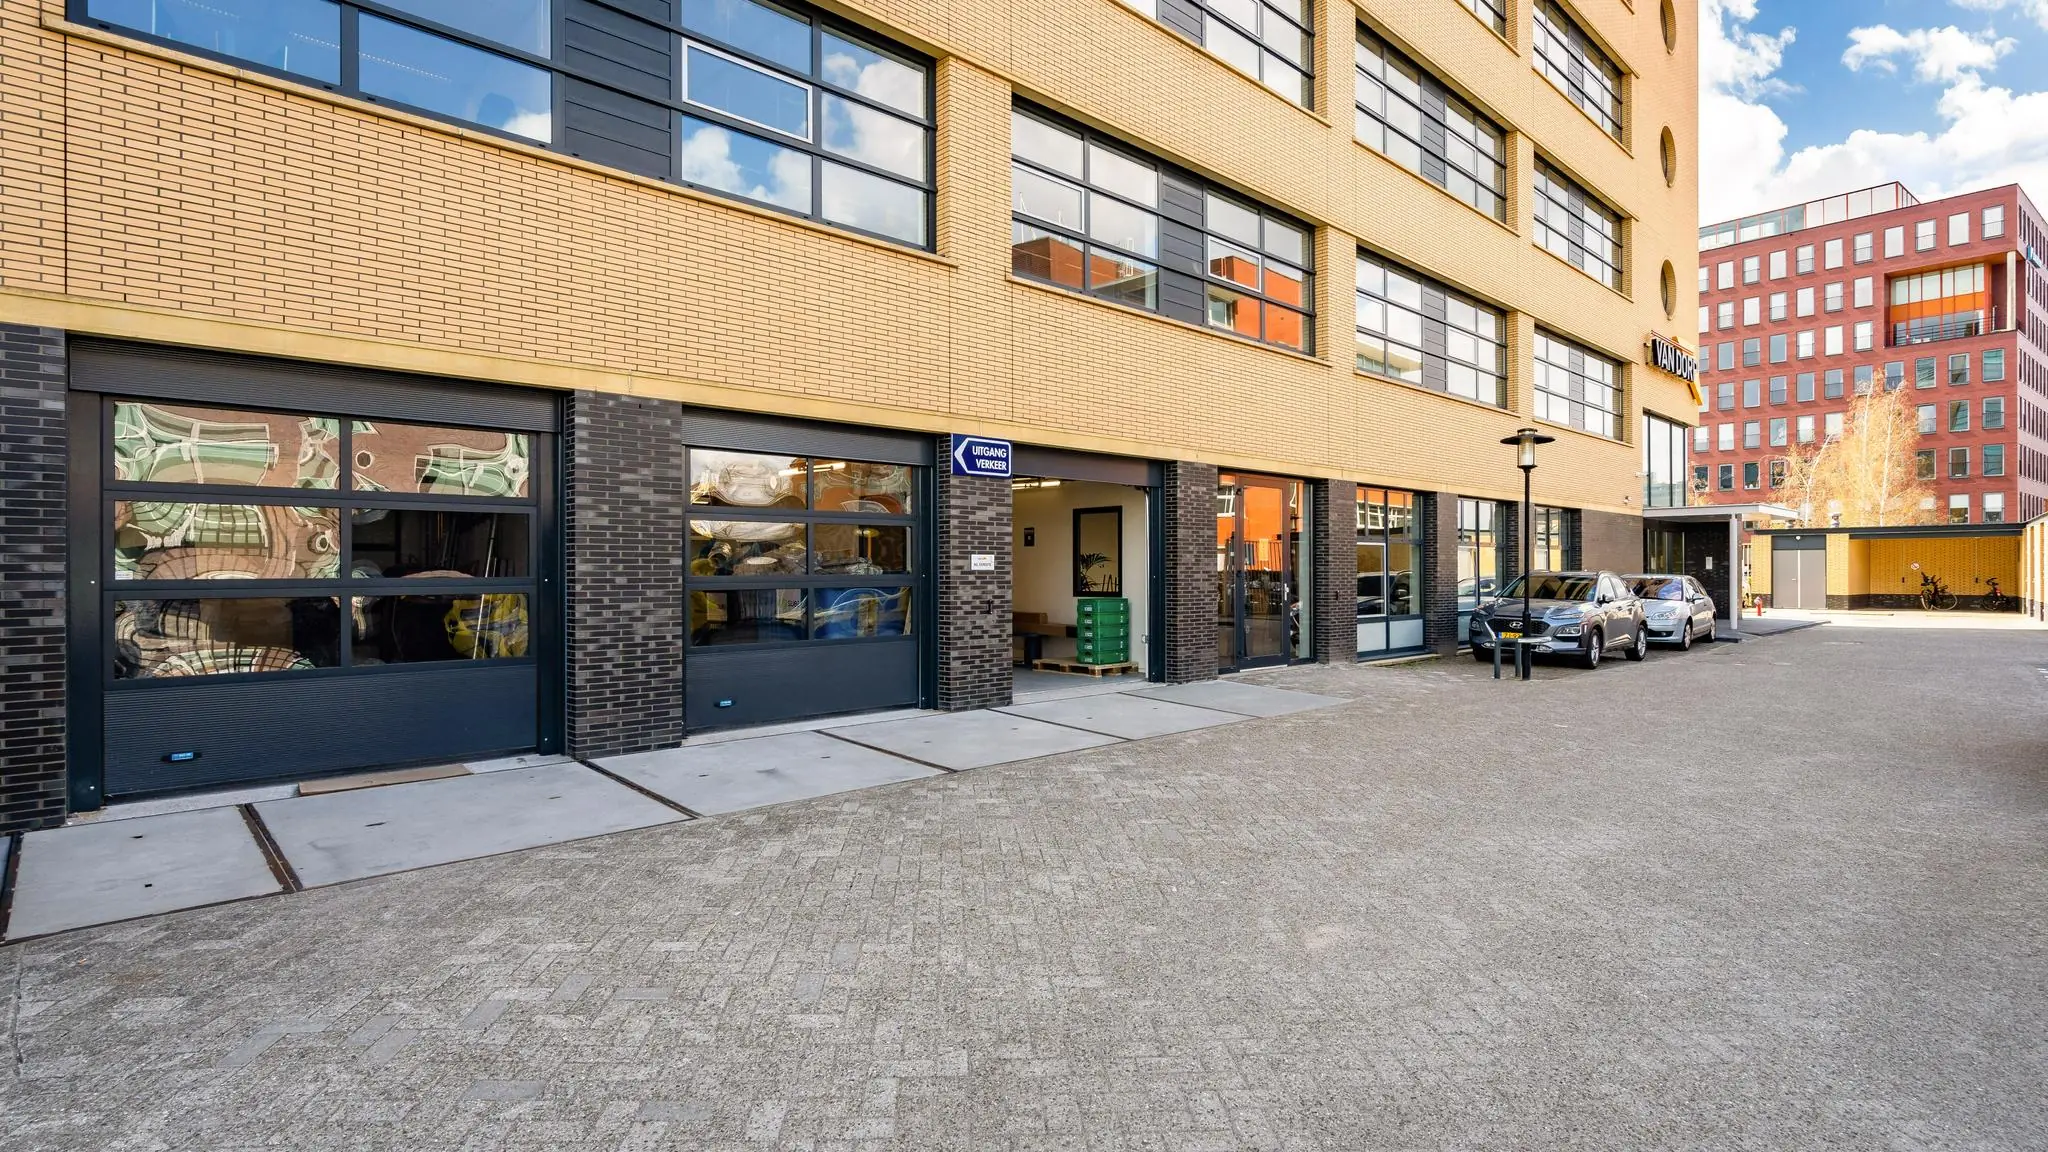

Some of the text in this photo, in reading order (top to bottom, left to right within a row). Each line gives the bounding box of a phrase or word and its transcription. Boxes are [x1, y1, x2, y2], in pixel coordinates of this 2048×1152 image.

[1655, 338, 1698, 381] VAN DORP
[972, 445, 1007, 458] UITGANG
[975, 458, 1007, 471] VERKEER
